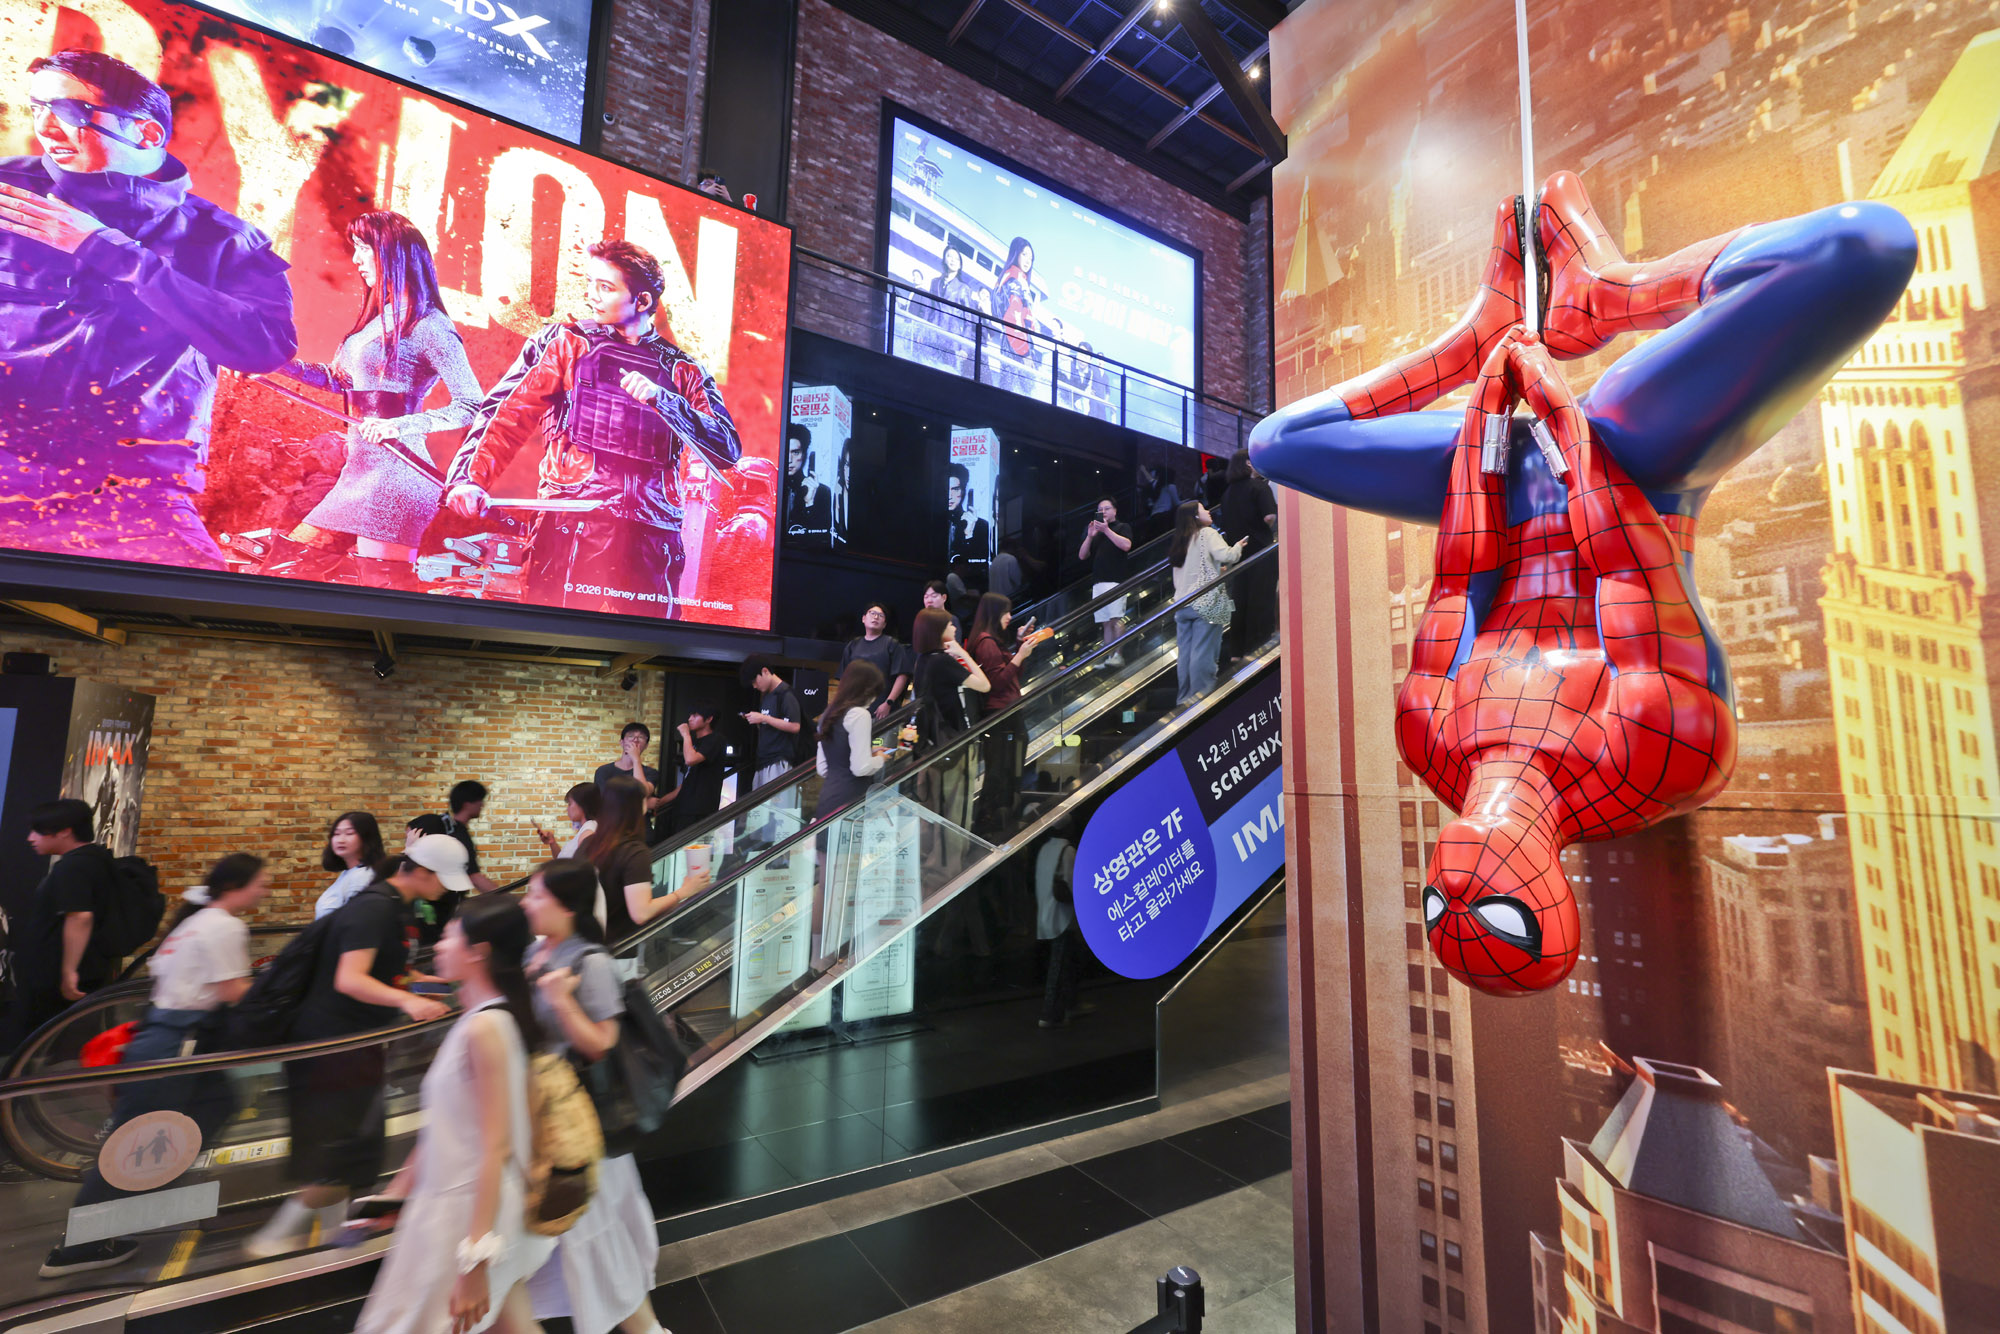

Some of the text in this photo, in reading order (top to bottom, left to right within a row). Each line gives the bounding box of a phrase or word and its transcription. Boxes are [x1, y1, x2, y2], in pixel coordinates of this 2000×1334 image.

[432, 16, 536, 66] EXPERIENCE
[575, 583, 602, 596] 2026
[603, 587, 636, 601] Disney
[637, 592, 657, 602] and
[657, 593, 669, 604] its
[670, 596, 701, 607] related
[702, 599, 733, 611] entities
[84, 730, 137, 766] IMAX
[1197, 739, 1231, 772] 1-2관
[1236, 710, 1269, 741] 5-7관
[1210, 730, 1282, 801] SCREENX
[1093, 806, 1184, 895] 상영관은 7F
[1107, 838, 1196, 921] 에스컬레이터를
[1117, 860, 1205, 942] 타고 올라가세요
